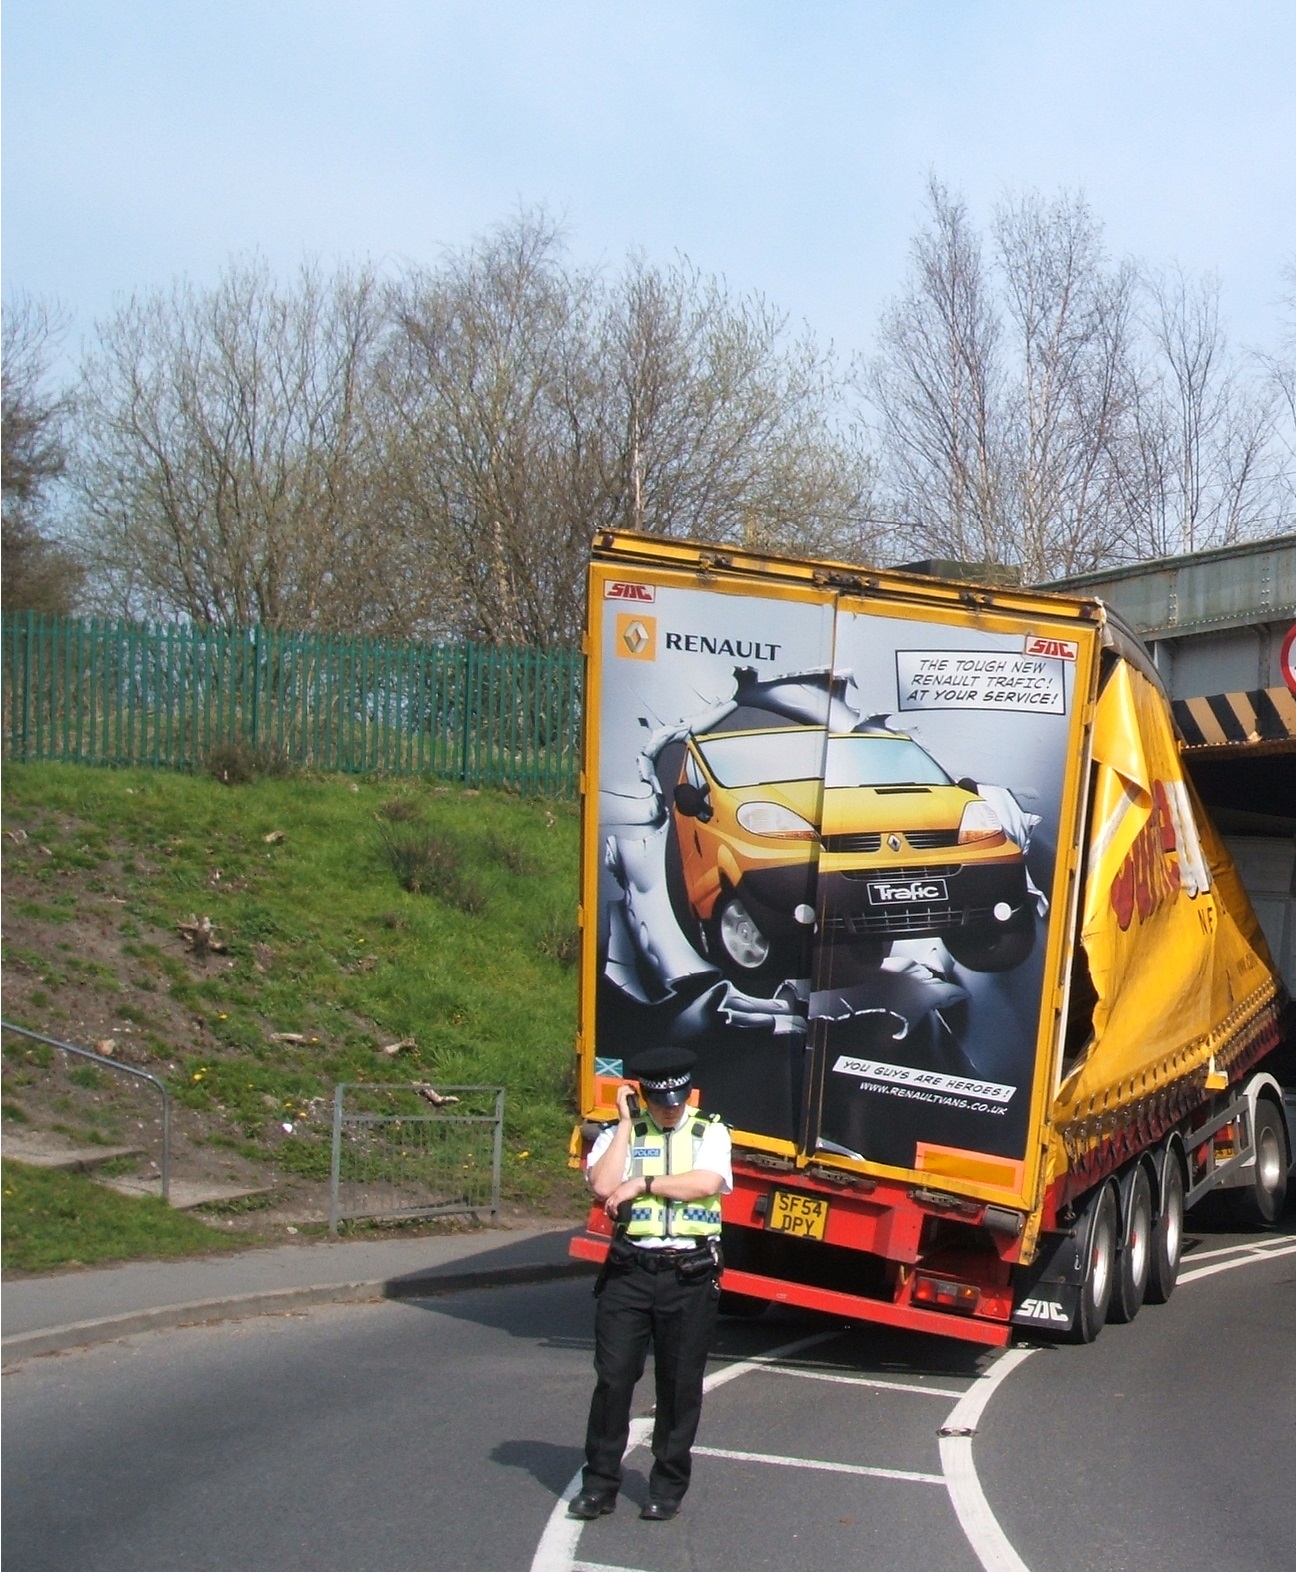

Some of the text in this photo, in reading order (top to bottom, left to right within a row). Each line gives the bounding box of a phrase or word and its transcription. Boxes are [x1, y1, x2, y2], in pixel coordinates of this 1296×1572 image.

[606, 583, 653, 600] SDC
[665, 632, 782, 661] RENAULT
[1028, 640, 1074, 658] SDC
[919, 659, 1046, 674] THE TOUGH NEW
[911, 674, 1054, 690] RENAULT TRAFIC!
[906, 690, 1059, 705] AT YOUR SERVICE!
[873, 882, 940, 901] Trafic
[843, 1061, 1011, 1098] YOU GUYS ARE HEROES!
[778, 1195, 822, 1218] SF54
[781, 1214, 815, 1235] DPY
[1014, 1298, 1069, 1322] SDC
